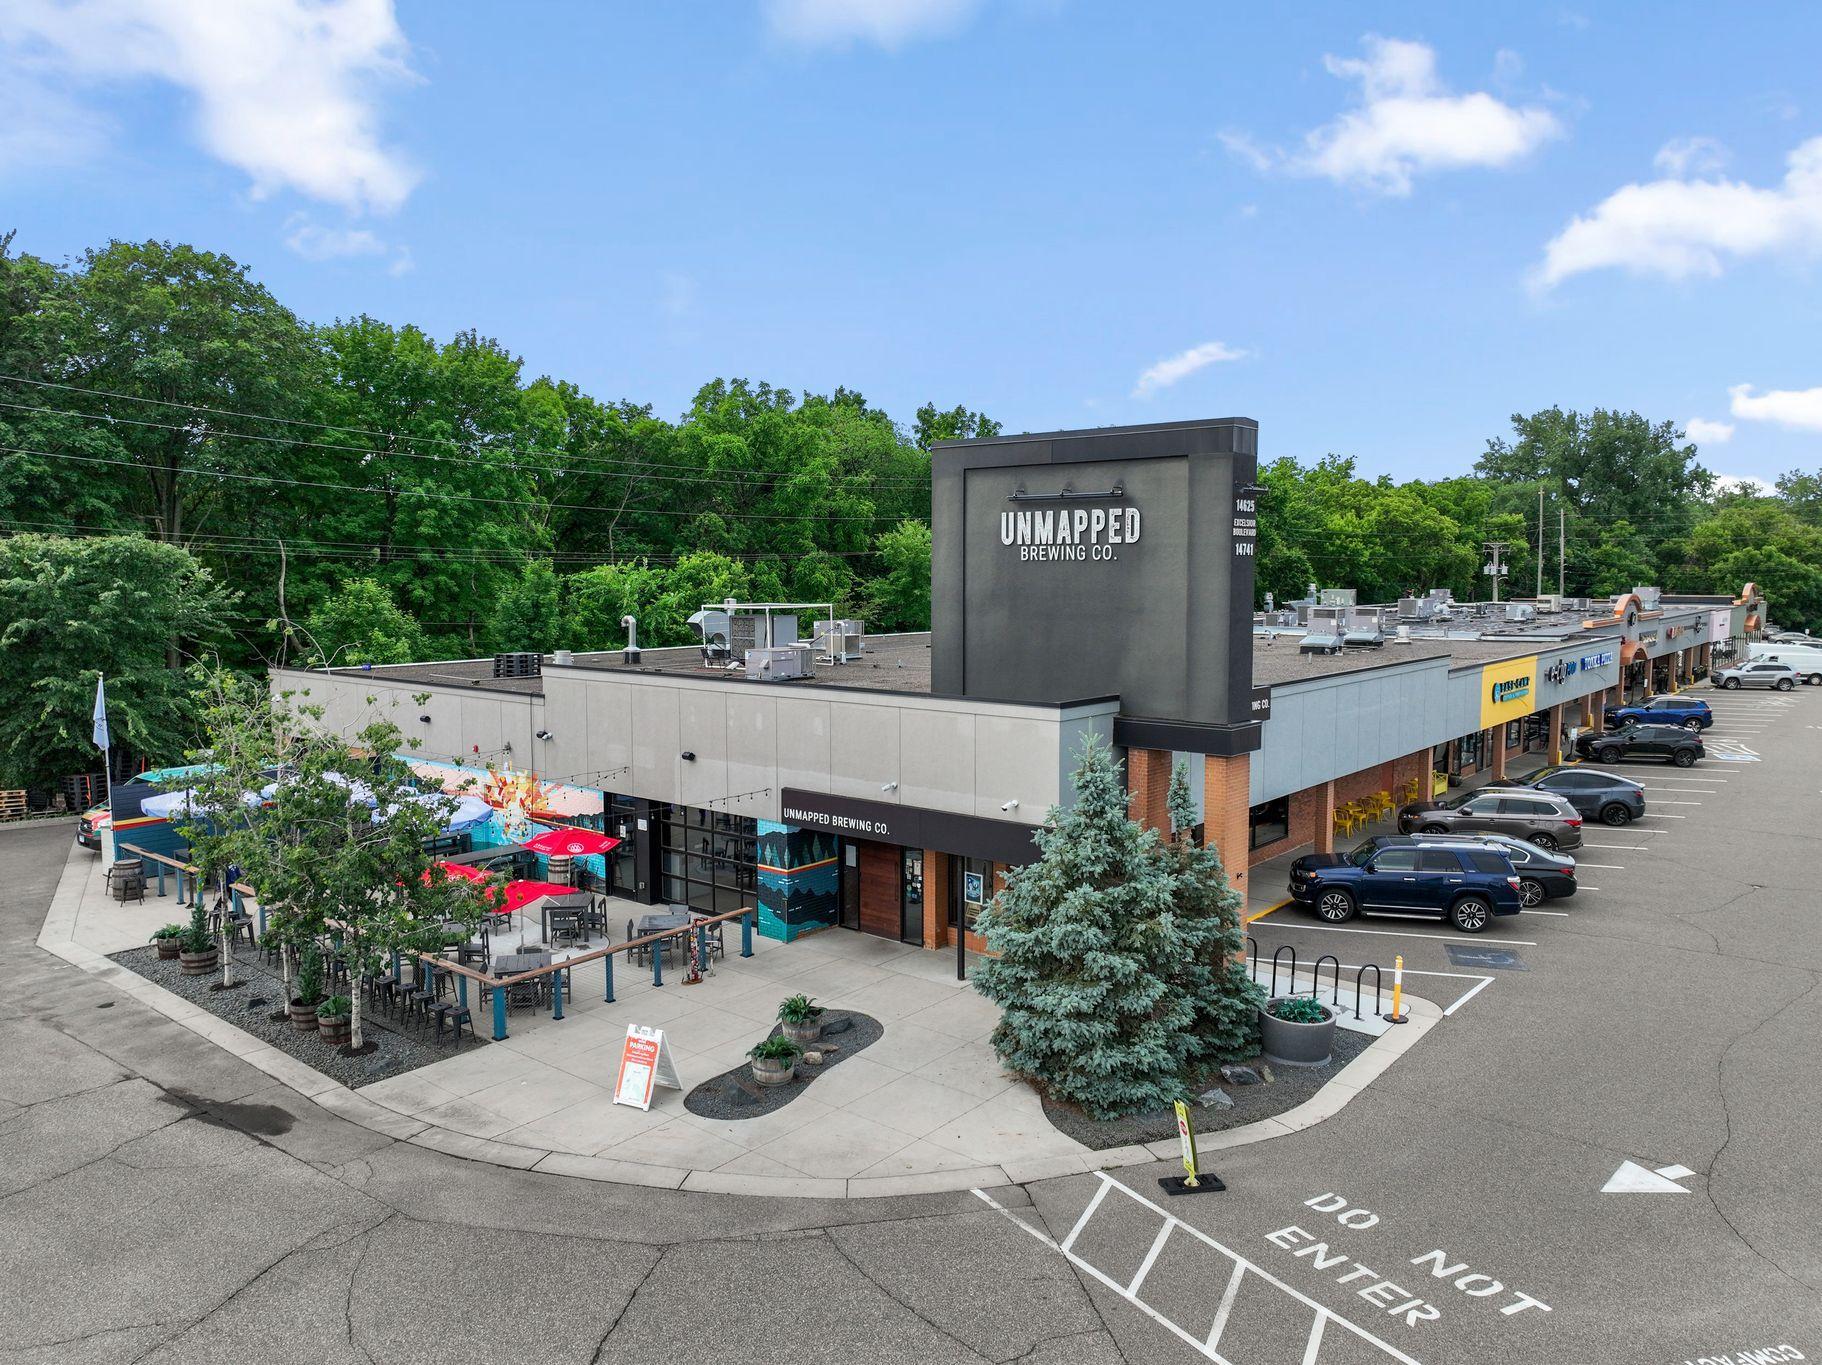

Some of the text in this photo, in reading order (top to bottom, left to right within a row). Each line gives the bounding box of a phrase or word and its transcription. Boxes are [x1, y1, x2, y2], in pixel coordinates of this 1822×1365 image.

[1236, 499, 1255, 512] 14625
[1001, 507, 1141, 546] UNMAPPED
[1020, 544, 1118, 561] BREWING CO.
[1235, 543, 1254, 556] 14741
[783, 807, 890, 835] UNMAPPED BREWING CO.
[629, 1041, 655, 1053] PARKING
[1303, 1192, 1553, 1316] DO NOT
[1264, 1225, 1441, 1328] ENTER
